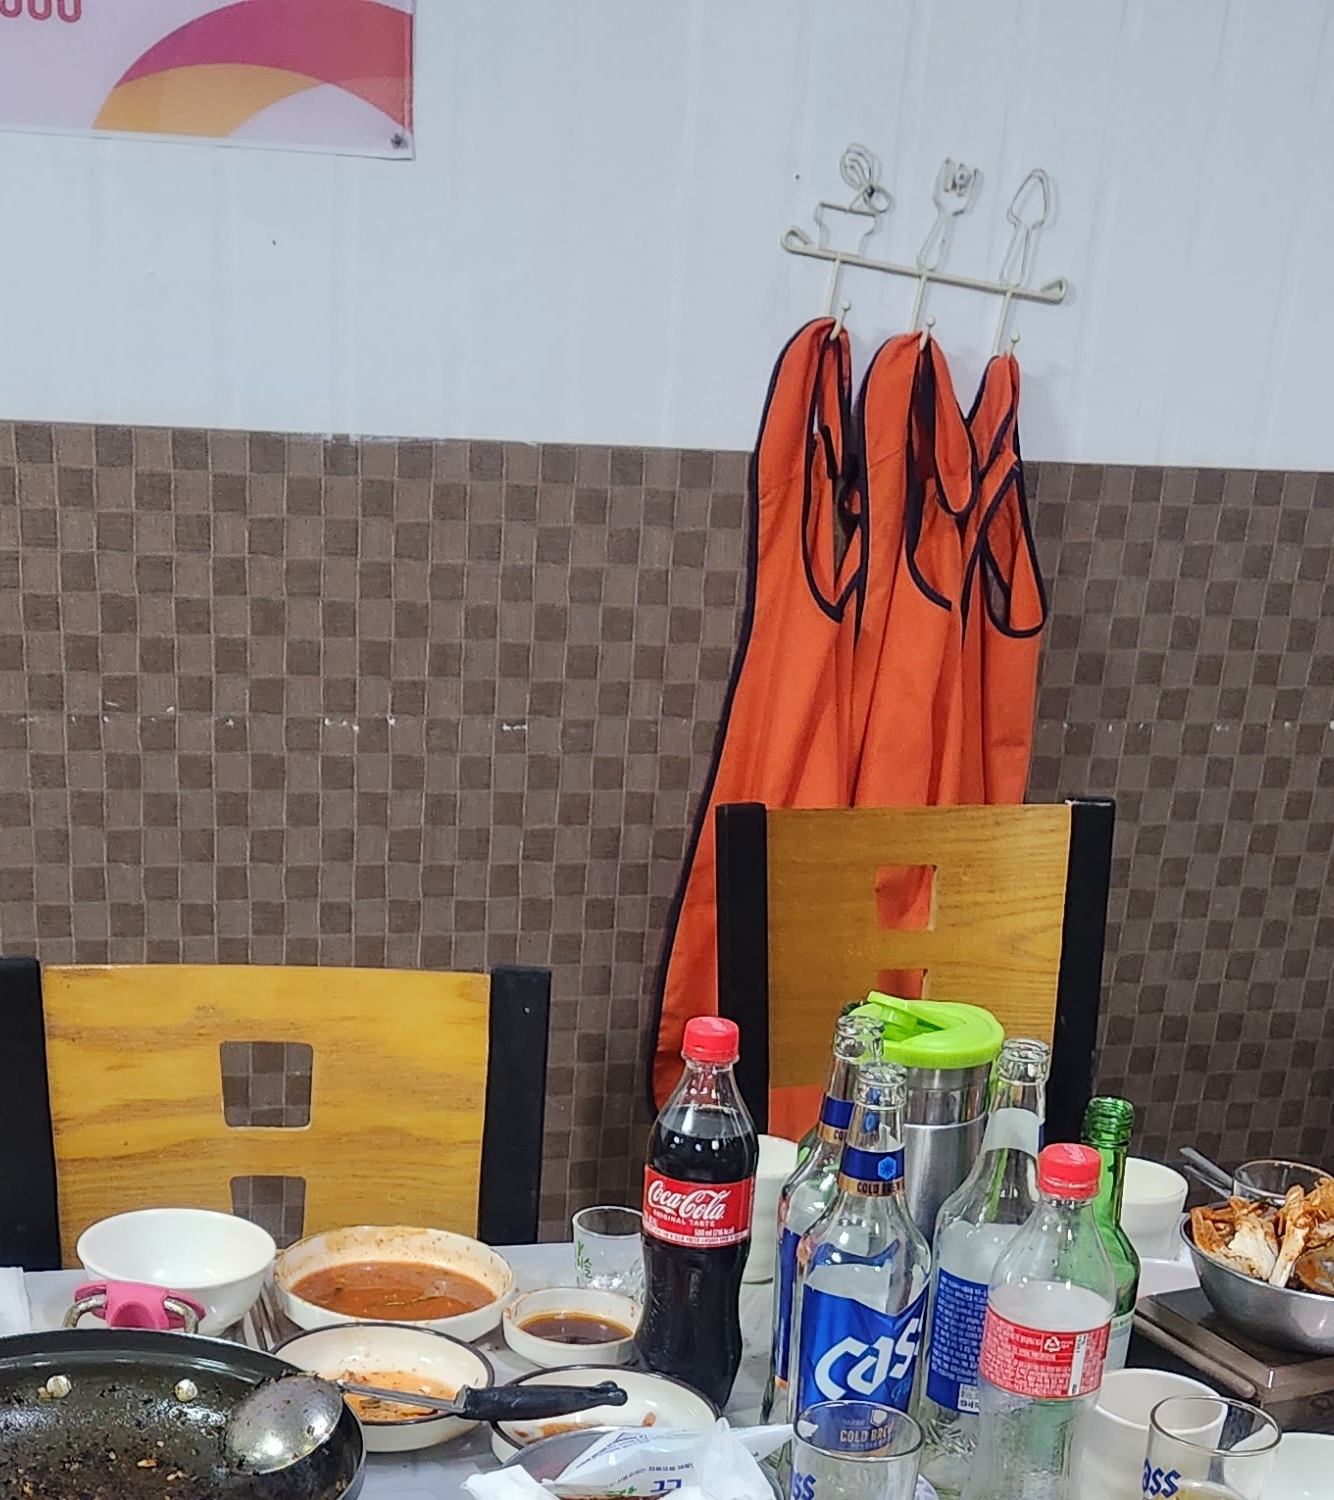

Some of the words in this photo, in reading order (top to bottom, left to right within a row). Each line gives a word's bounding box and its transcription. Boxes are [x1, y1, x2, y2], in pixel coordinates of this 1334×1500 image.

[648, 1180, 731, 1221] Coca-Cola
[857, 1182, 879, 1195] COLD
[653, 1209, 686, 1226] ORIGINAL
[689, 1219, 715, 1228] TASTE
[815, 1318, 926, 1400] Cas
[840, 1429, 868, 1443] COLD
[1142, 1458, 1182, 1499] ass
